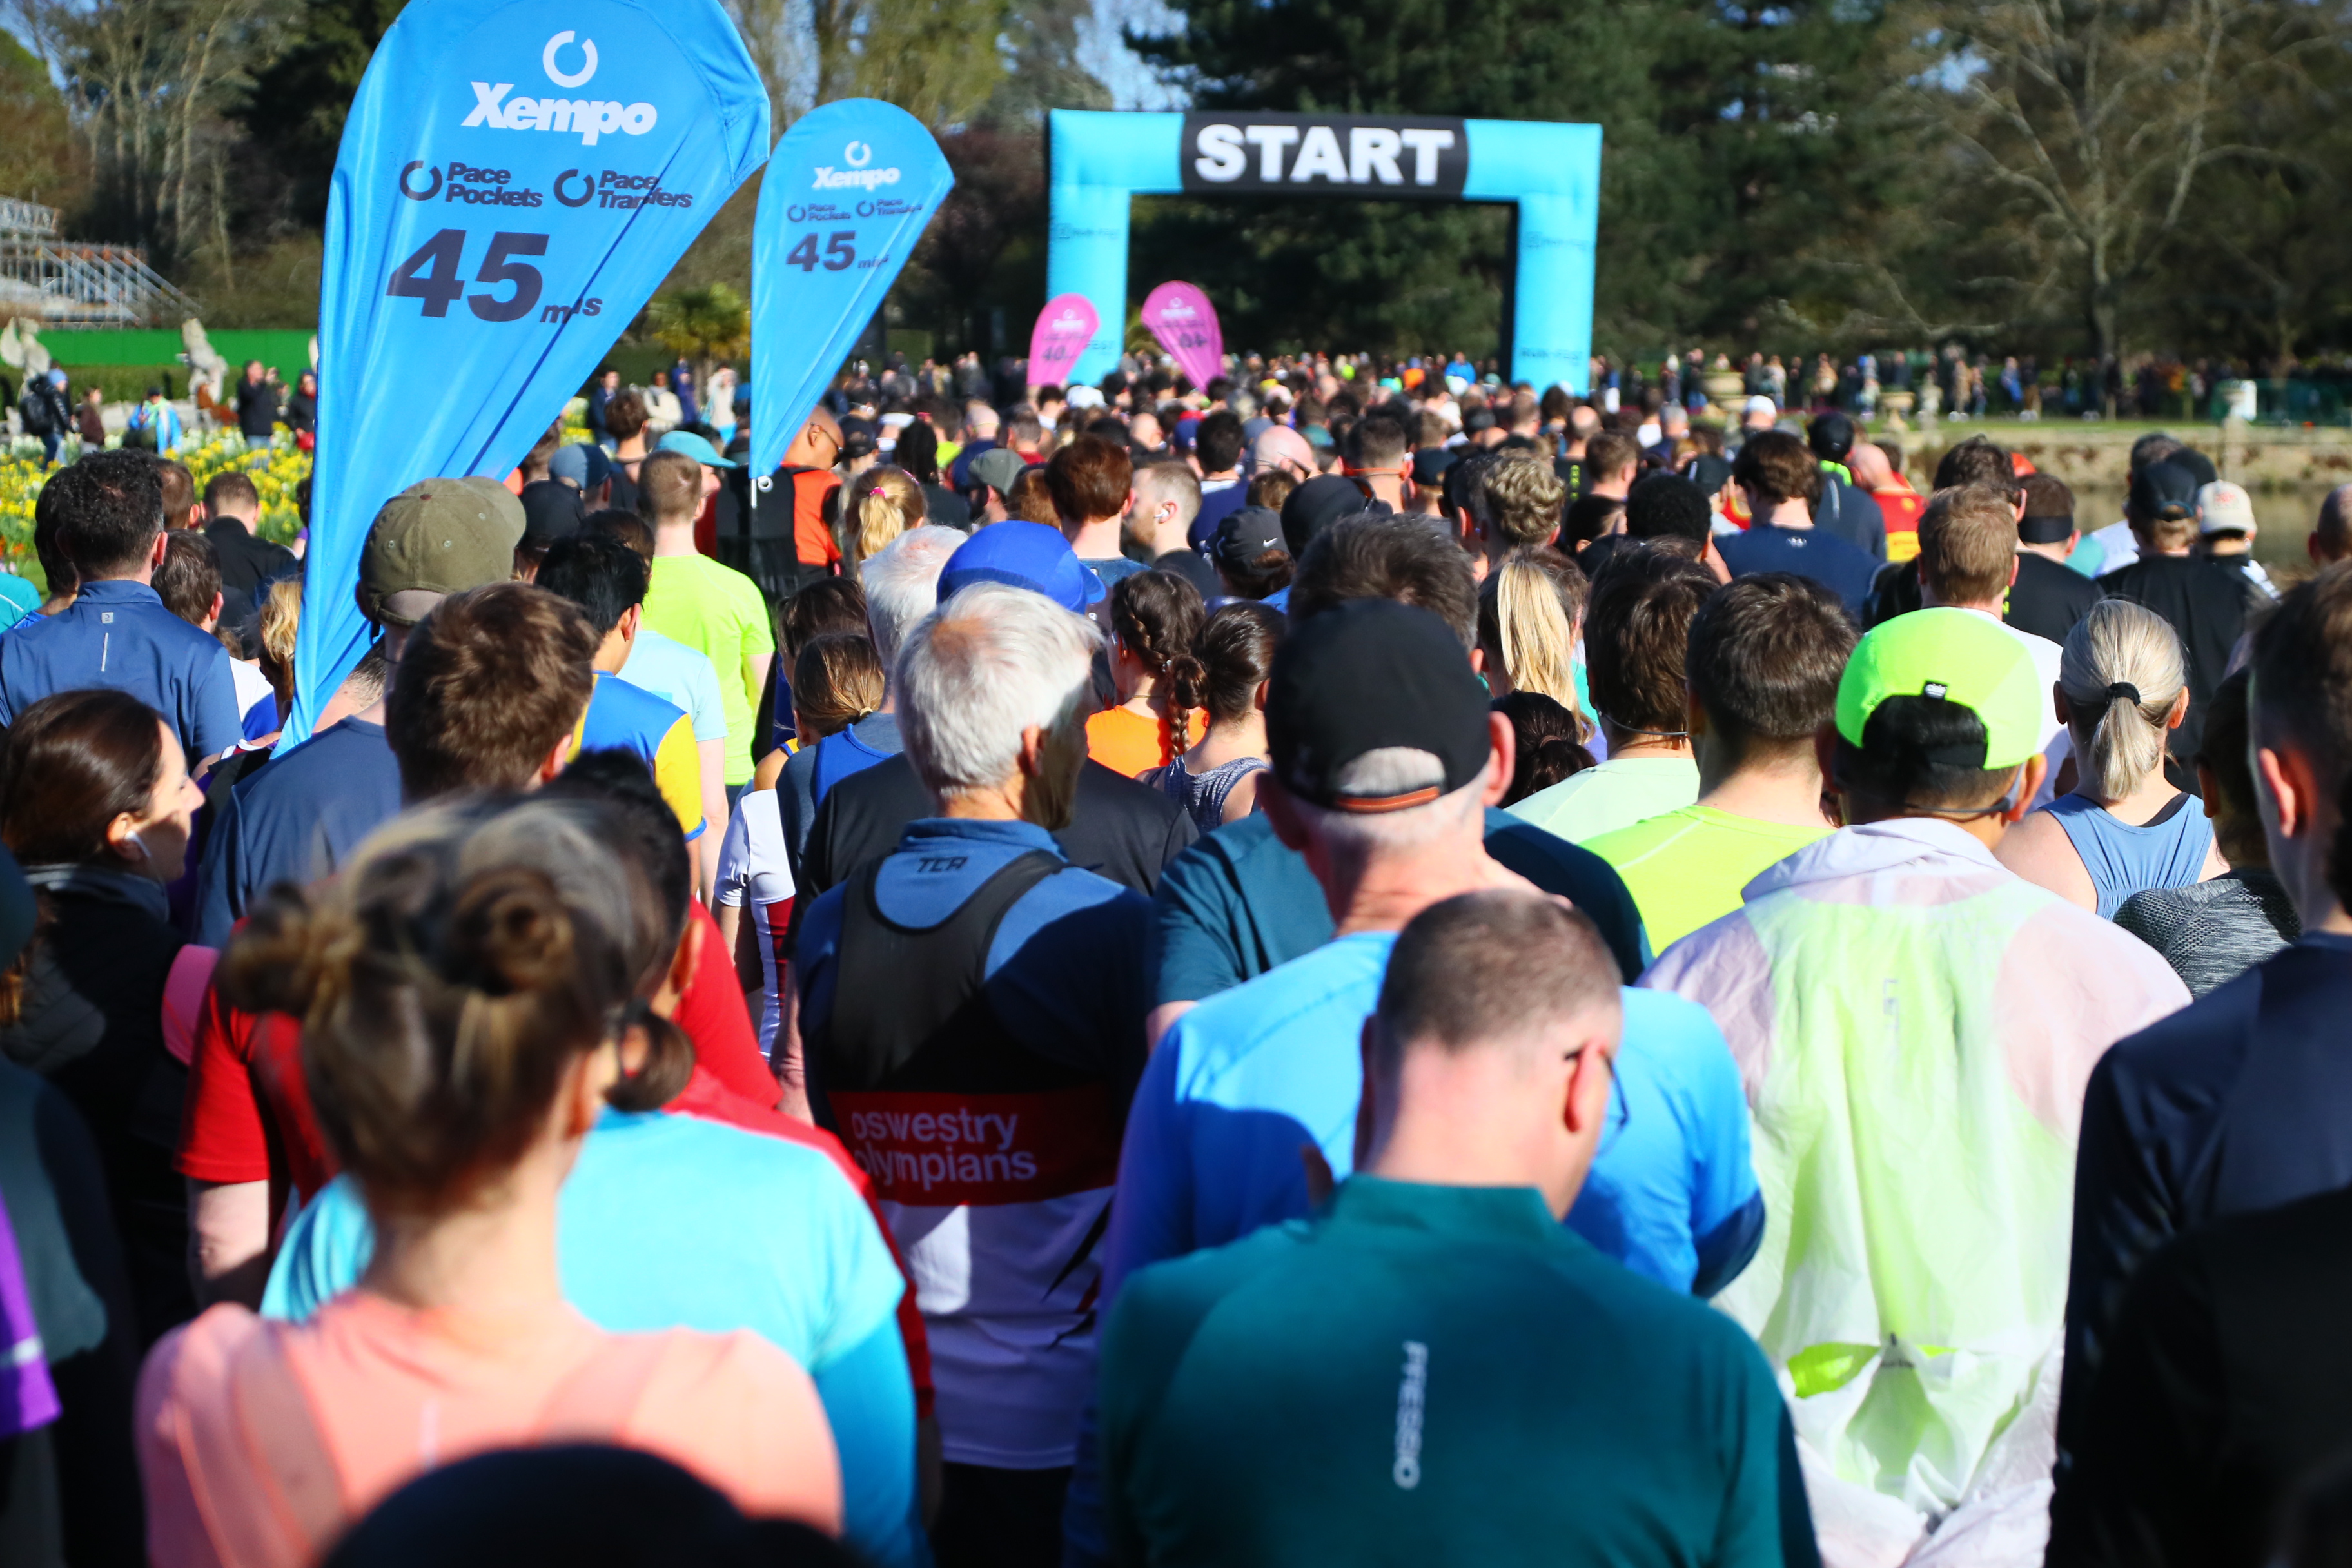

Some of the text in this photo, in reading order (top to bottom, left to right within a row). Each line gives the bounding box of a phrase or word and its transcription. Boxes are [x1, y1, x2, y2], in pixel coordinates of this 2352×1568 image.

[460, 81, 657, 146] Xempo
[1195, 124, 1454, 186] START
[446, 162, 511, 184] Pace
[598, 170, 660, 190] Pace
[812, 166, 901, 190] Xempo
[445, 184, 544, 208] Pockets
[598, 187, 694, 209] Tranfers
[786, 230, 856, 271] 45
[385, 228, 549, 322] 45
[1041, 345, 1066, 360] 40
[852, 1108, 1017, 1150] oswestry
